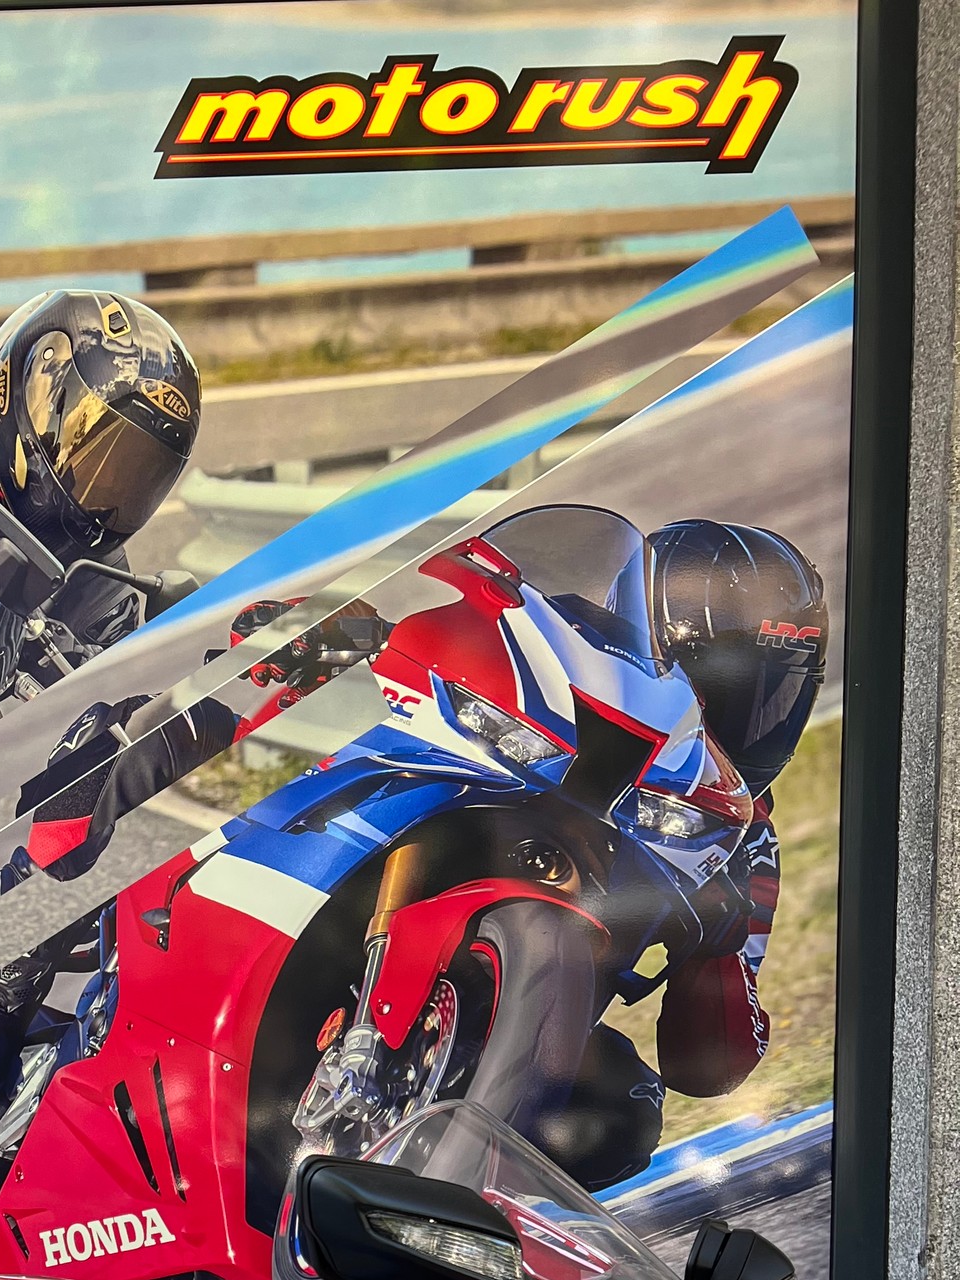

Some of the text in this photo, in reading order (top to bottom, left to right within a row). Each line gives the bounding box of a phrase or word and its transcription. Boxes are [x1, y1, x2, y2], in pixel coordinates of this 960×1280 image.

[174, 50, 782, 159] moto rush
[147, 381, 189, 419] X-lite
[756, 619, 821, 653] HRC
[604, 644, 647, 671] HONDA
[39, 1208, 176, 1267] HONDA
